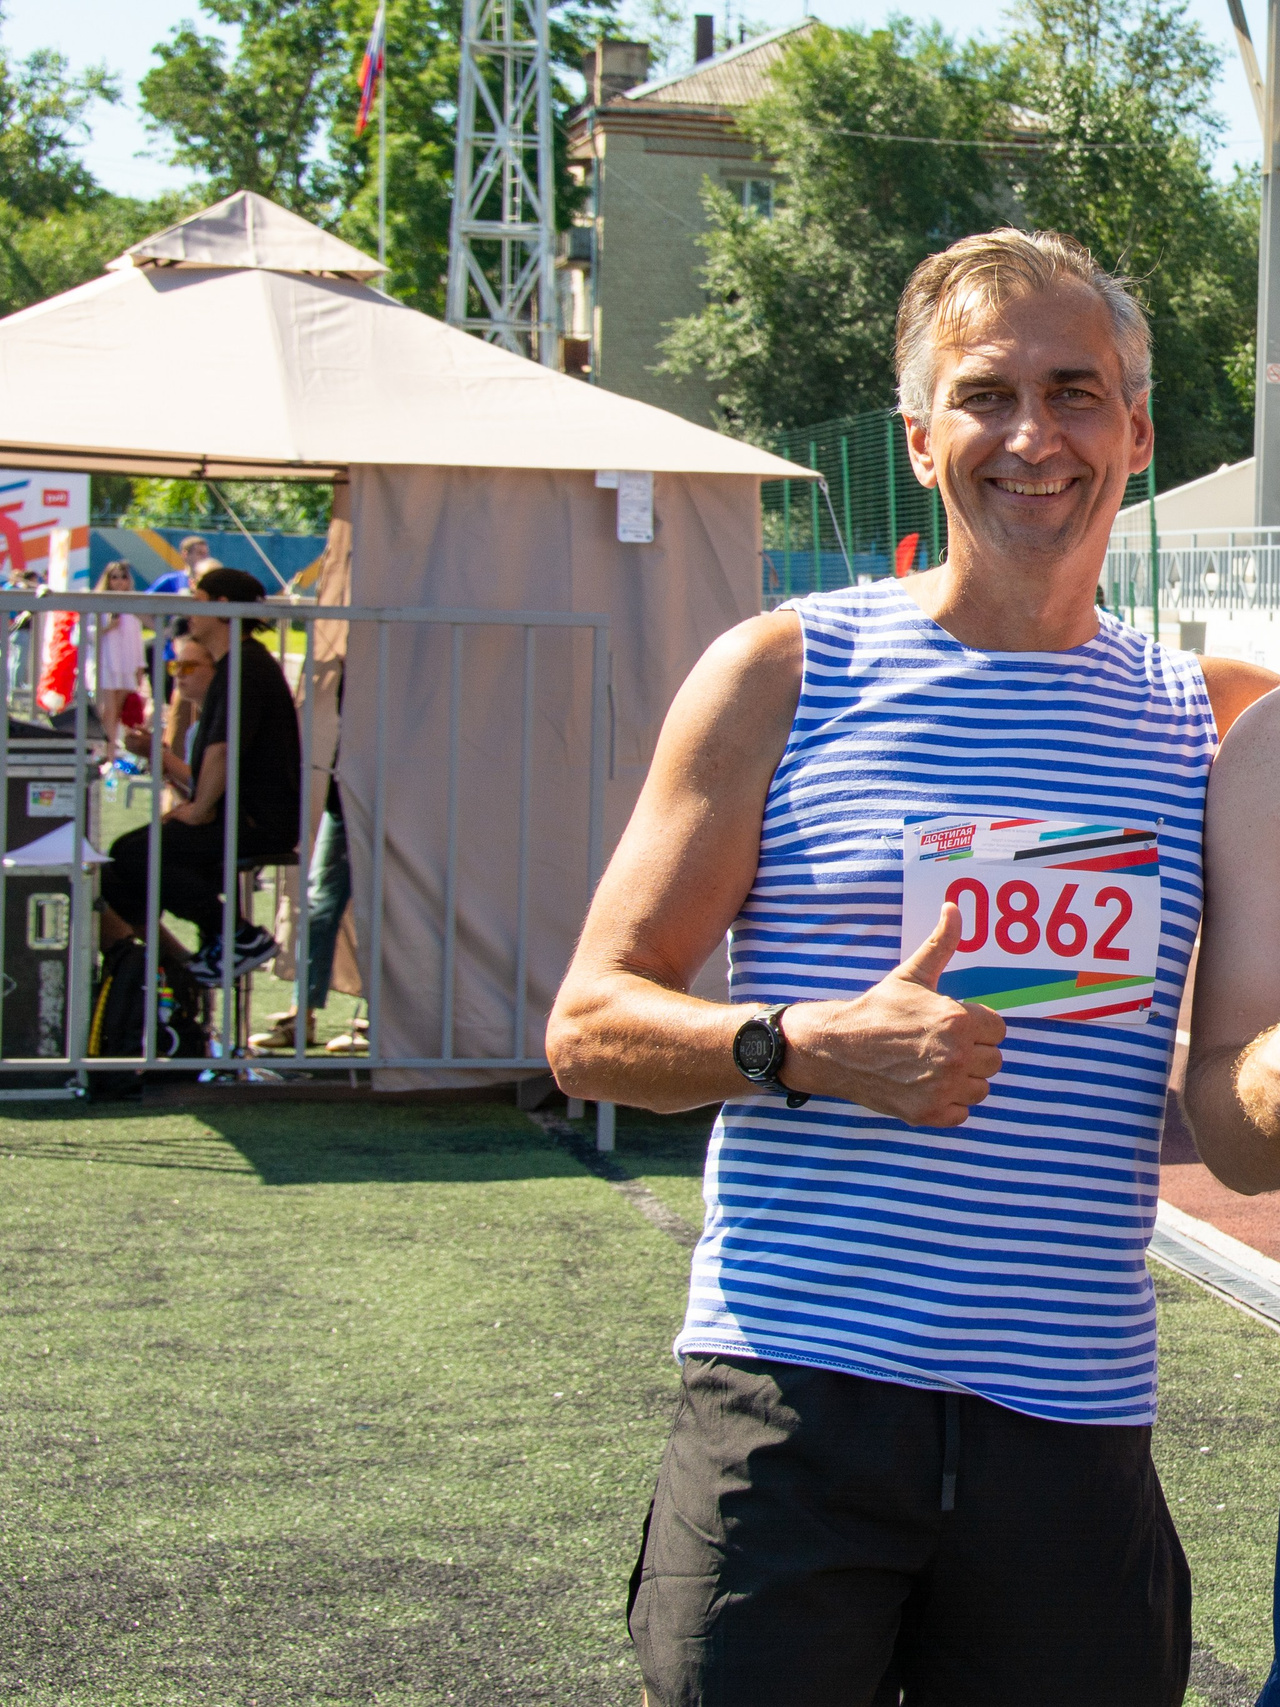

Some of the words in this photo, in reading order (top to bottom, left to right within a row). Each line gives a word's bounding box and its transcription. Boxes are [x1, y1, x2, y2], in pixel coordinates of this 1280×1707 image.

[923, 826, 973, 845] ДОСТИГАЯ
[939, 835, 971, 850] ЦЕЛИ!
[944, 877, 1133, 962] 0862
